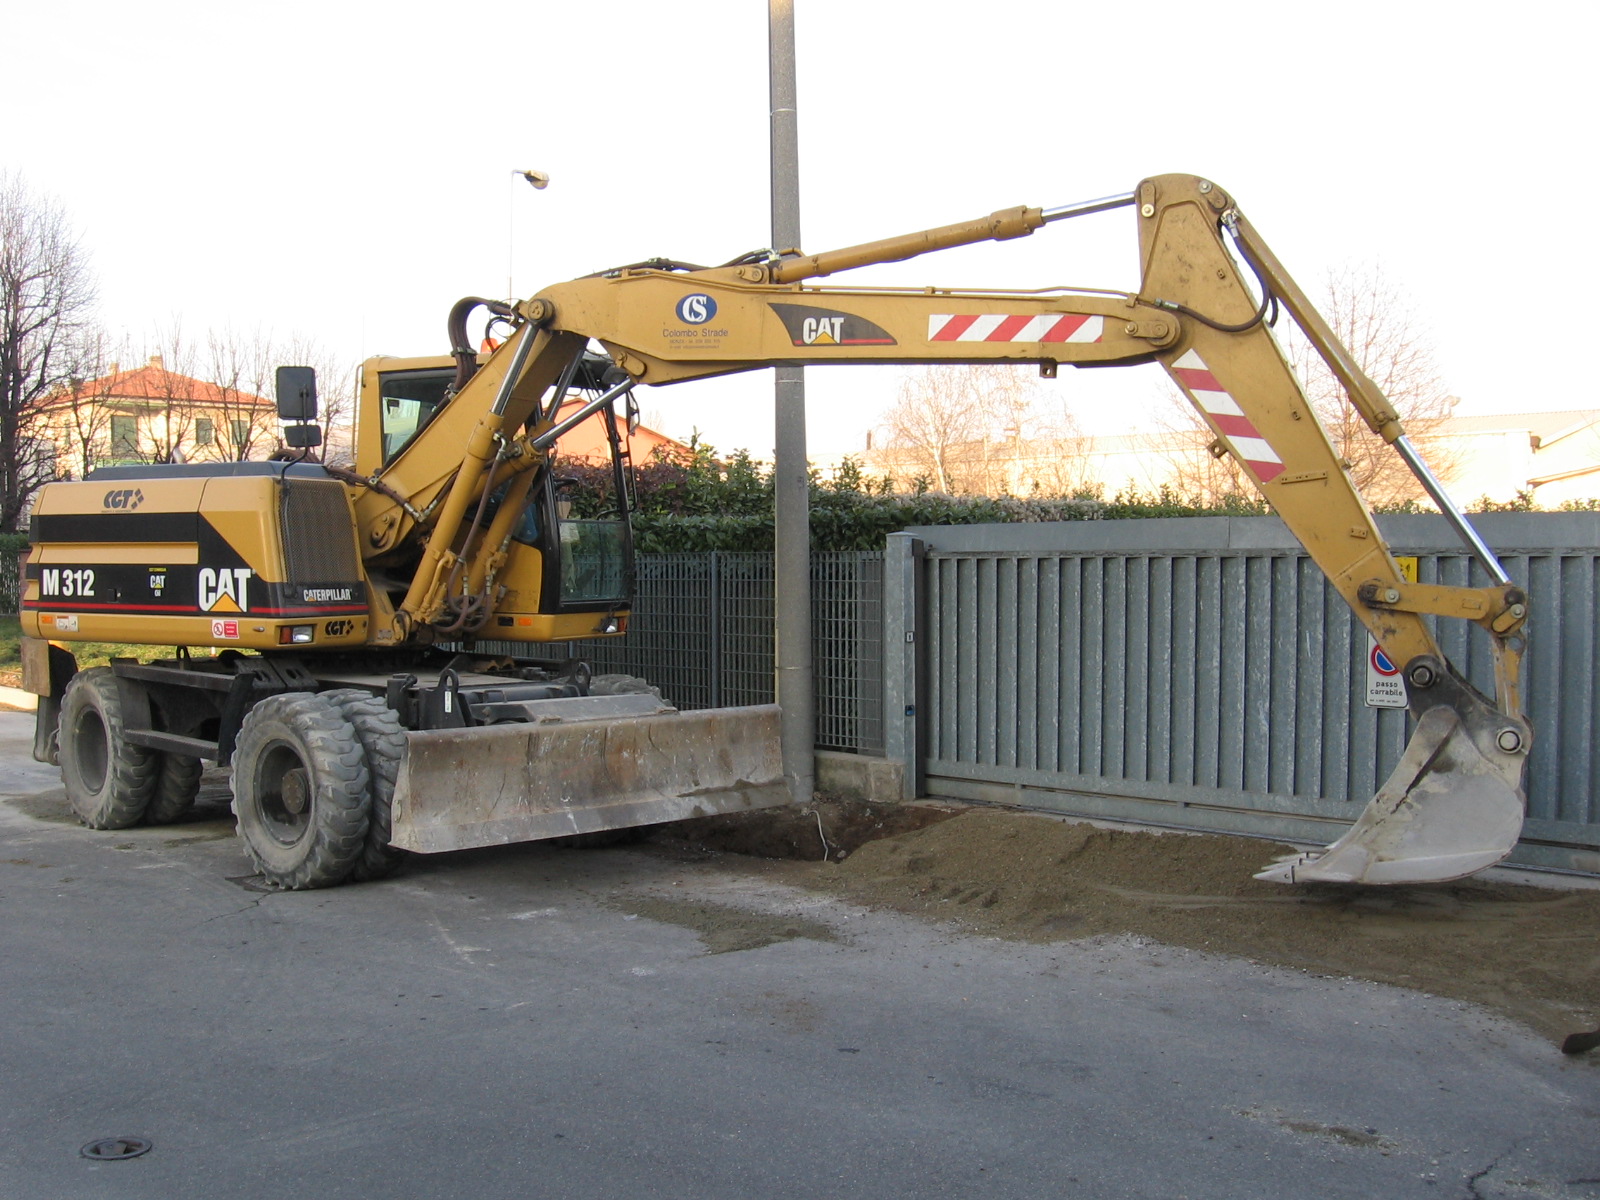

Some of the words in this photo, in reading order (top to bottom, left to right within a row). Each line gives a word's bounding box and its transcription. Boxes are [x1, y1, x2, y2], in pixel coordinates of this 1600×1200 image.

[662, 328, 698, 338] Colombo
[702, 328, 729, 337] Strade
[803, 317, 844, 344] CAT
[43, 569, 60, 596] M
[62, 569, 95, 597] 312
[150, 575, 166, 589] CAT
[198, 568, 252, 612] CAT
[303, 588, 352, 602] CATERPILLAR
[1370, 689, 1403, 697] carrabile
